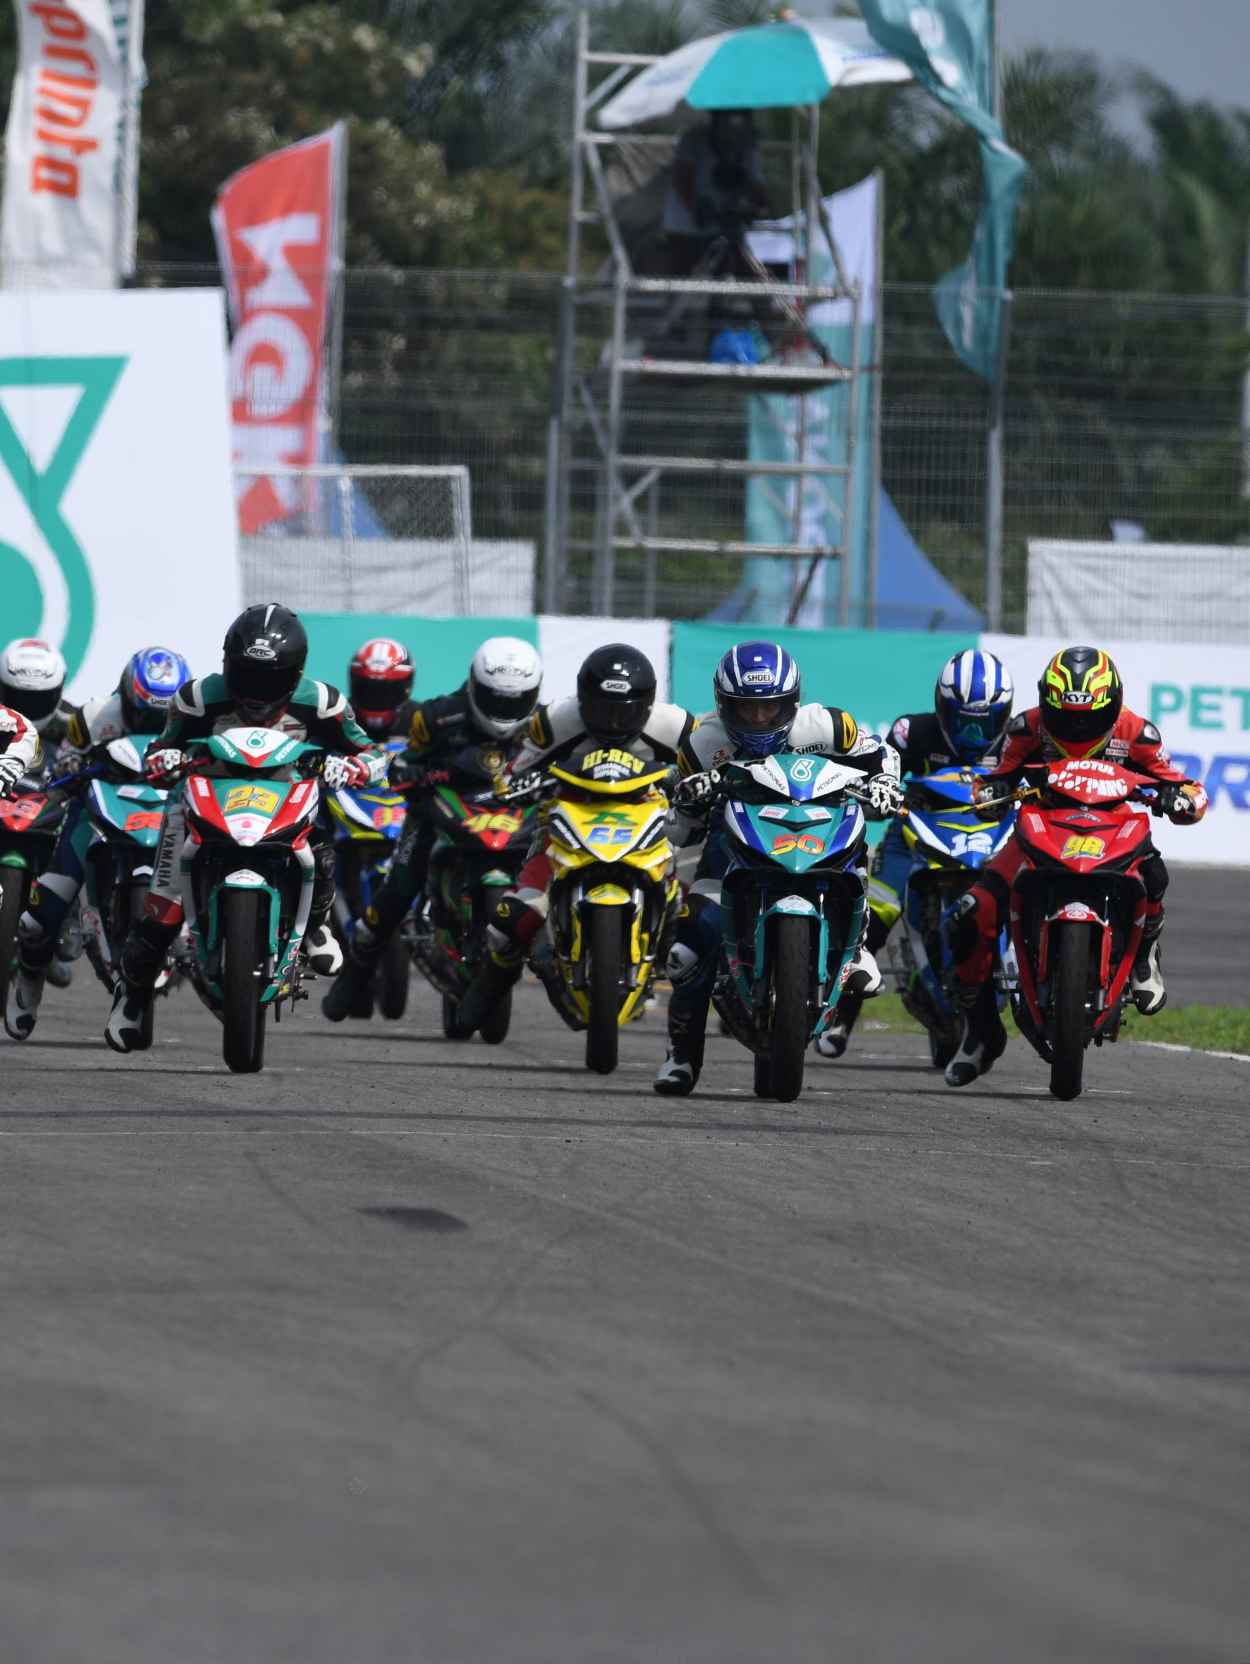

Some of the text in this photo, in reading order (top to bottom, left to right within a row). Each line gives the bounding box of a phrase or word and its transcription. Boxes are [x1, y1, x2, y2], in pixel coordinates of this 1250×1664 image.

[26, 0, 102, 200] printa
[746, 673, 772, 683] SHOEI
[1061, 692, 1094, 704] KYT
[796, 742, 826, 755] SHOEI
[582, 748, 646, 774] HI-REV
[1066, 760, 1116, 776] MOTUL
[761, 764, 786, 791] PETRONAS
[816, 771, 843, 793] PETRONAS
[223, 785, 281, 815] 23
[462, 812, 524, 834] 46
[586, 826, 634, 846] 65
[769, 833, 826, 857] 50
[949, 831, 994, 857] 12
[1061, 834, 1106, 860] 98
[157, 833, 176, 888] YAMAHA
